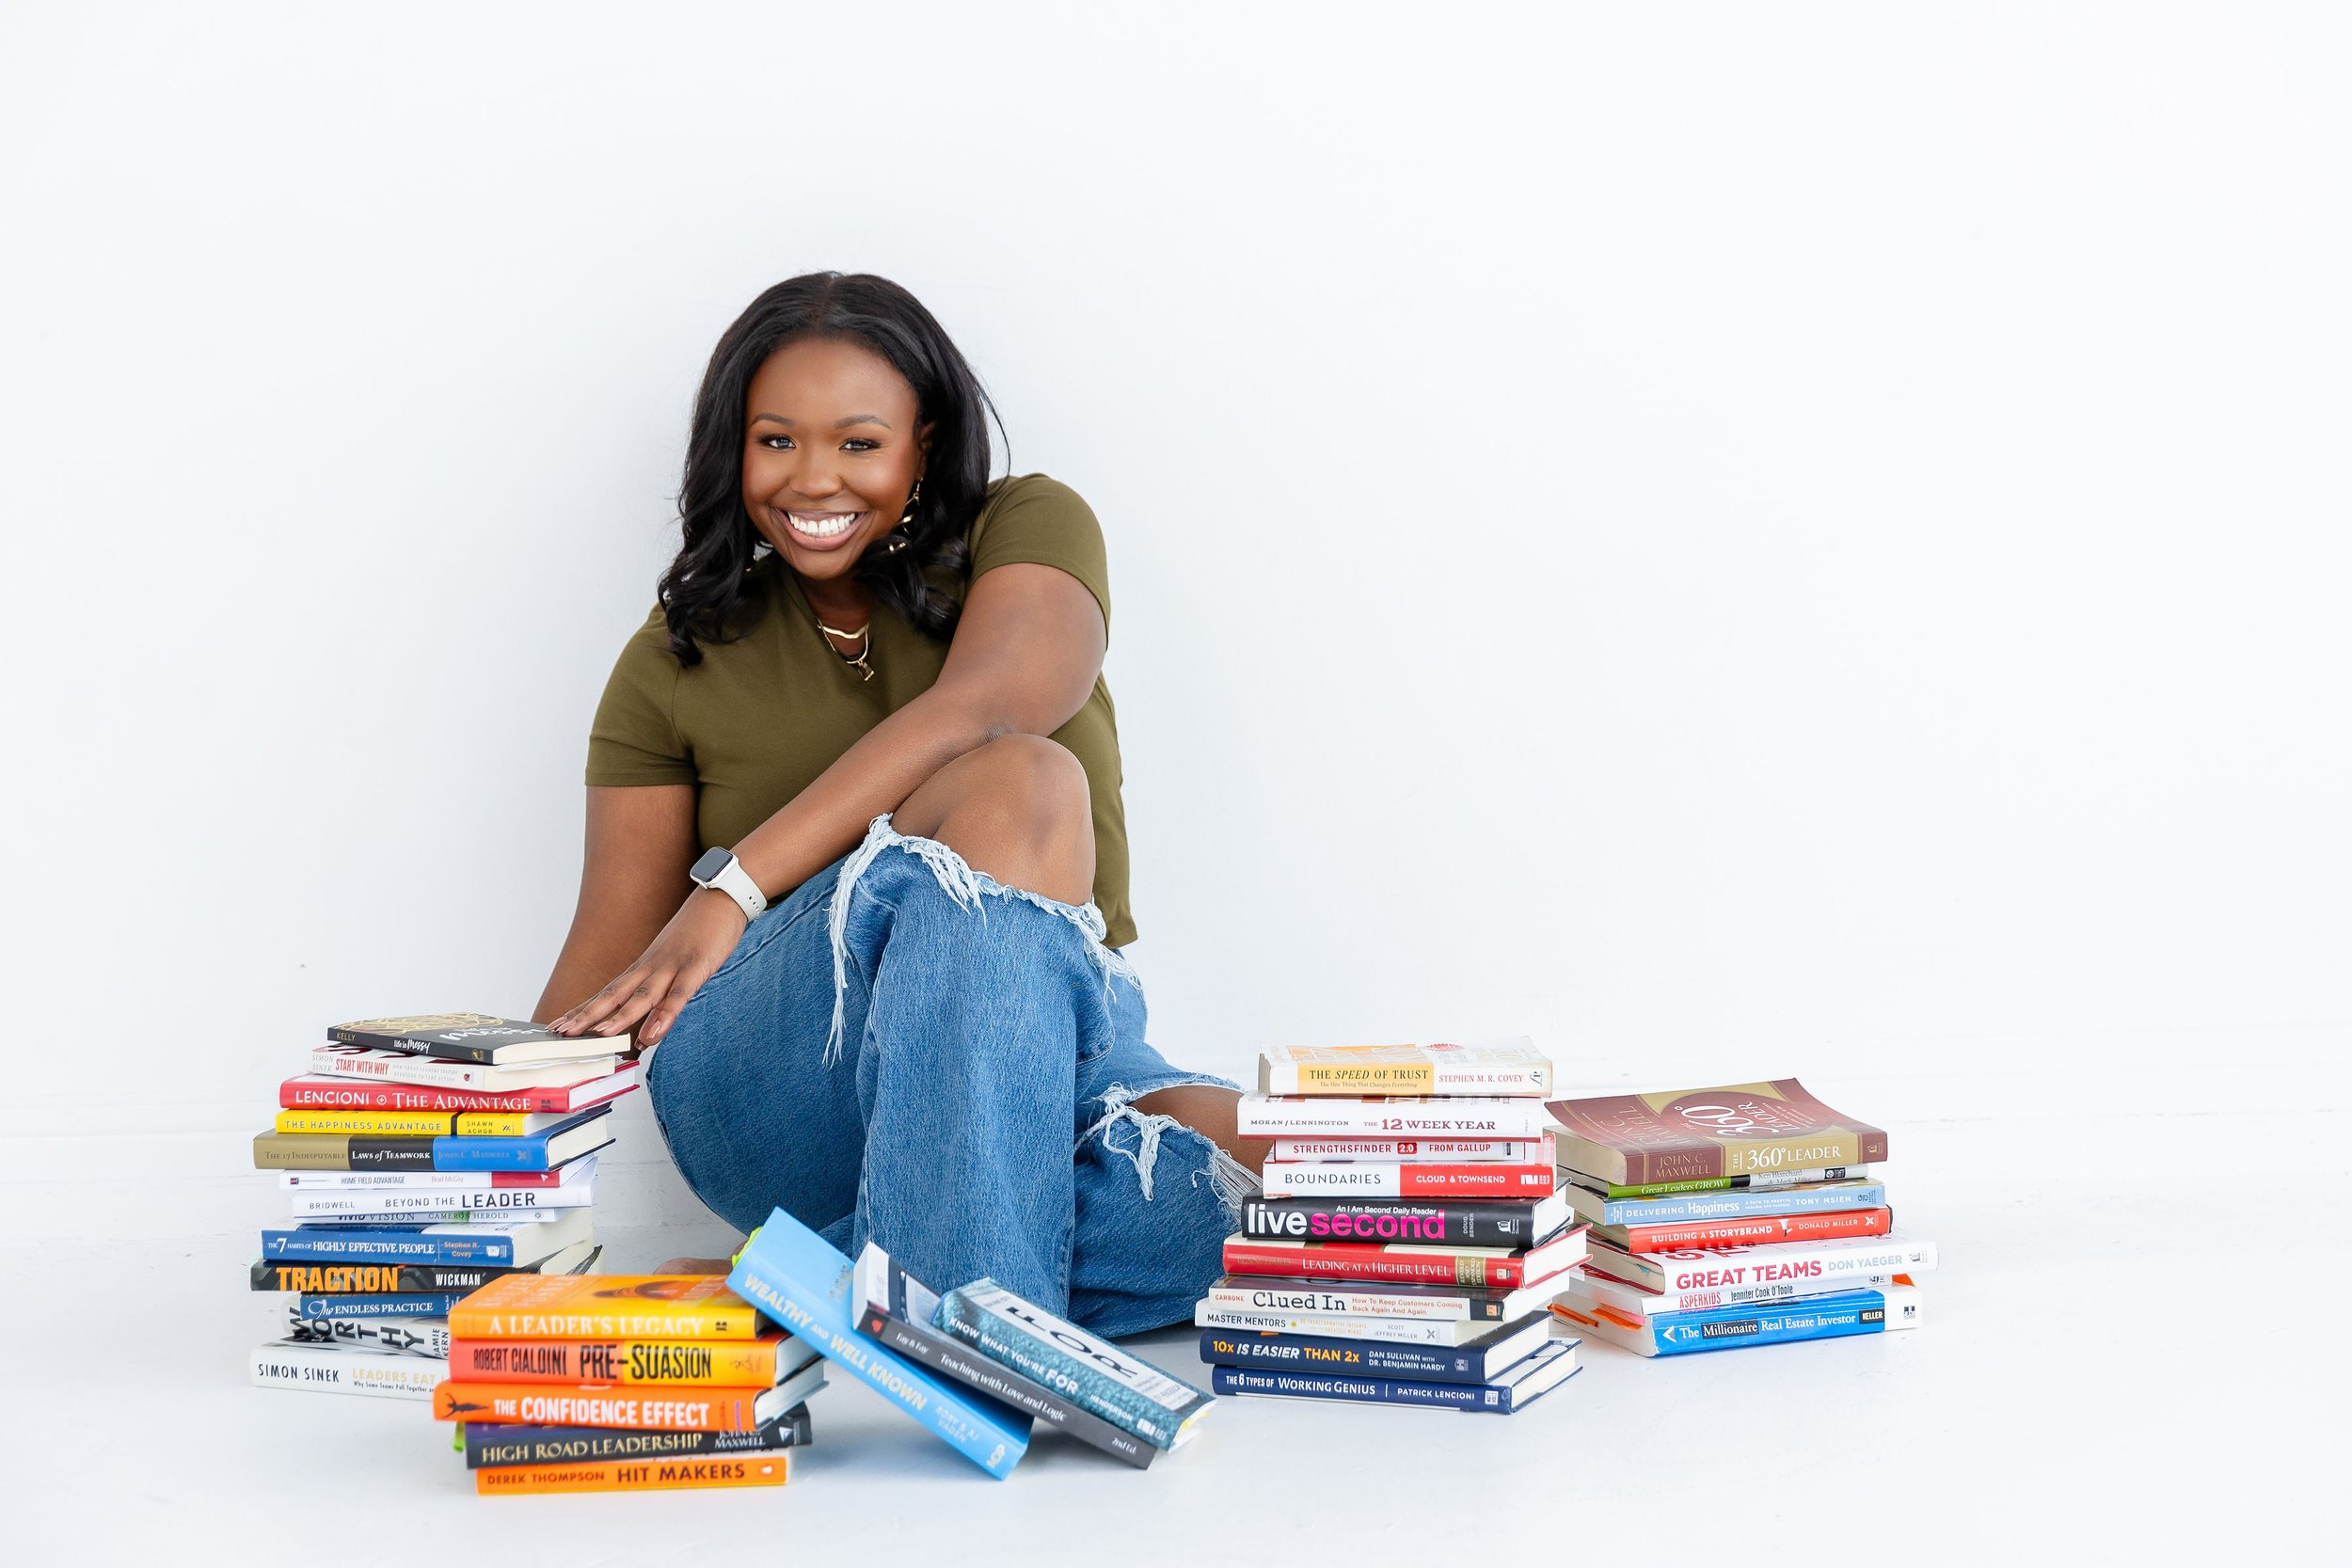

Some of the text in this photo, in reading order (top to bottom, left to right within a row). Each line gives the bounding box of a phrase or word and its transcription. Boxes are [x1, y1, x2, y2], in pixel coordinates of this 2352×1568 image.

[337, 1032, 356, 1041] KELLY
[336, 1059, 389, 1075] START WITH WHY
[1310, 1070, 1330, 1079] THE
[1335, 1070, 1369, 1079] SPEED
[1375, 1070, 1388, 1079] OF
[1392, 1070, 1428, 1080] TRUST
[296, 1091, 532, 1110] LENCIONI THE ADVANTAGE
[1382, 1119, 1403, 1129] 12
[1406, 1120, 1451, 1129] WEEK
[374, 1151, 384, 1162] of
[1294, 1145, 1391, 1153] STRENGTHSFINDER
[1400, 1143, 1414, 1152] 2.0
[1457, 1144, 1490, 1152] GALLUP
[1788, 1147, 1841, 1161] LEADER
[1660, 1154, 1706, 1167] JOHN C.
[1285, 1174, 1381, 1183] BOUNDARIES
[1657, 1165, 1711, 1178] MAXWELL
[1642, 1180, 1725, 1194] Great Leaders GROW
[386, 1198, 429, 1208] BEYOND
[436, 1197, 454, 1206] THE
[462, 1193, 535, 1208] LEADER
[1627, 1207, 1684, 1216] DELIVERING
[1688, 1201, 1740, 1215] Happiness
[1248, 1204, 1445, 1239] live second
[1652, 1233, 1696, 1243] BUILDING
[1708, 1226, 1772, 1238] STORYBRAND
[1799, 1221, 1829, 1229] DONALD
[277, 1238, 286, 1253] 7
[313, 1243, 346, 1252] HIGHLY
[349, 1243, 396, 1251] EFFECTIVE
[398, 1243, 435, 1254] PEOPLE
[1302, 1259, 1349, 1271] LEADING
[1372, 1262, 1412, 1275] HIGHER
[1415, 1264, 1451, 1276] LEVEL
[1677, 1255, 1902, 1290] GREAT TEAMS DON YAEGER
[277, 1267, 480, 1291] TRACTION WICKMAN
[1253, 1291, 1316, 1309] Clued
[1322, 1295, 1345, 1310] In
[1398, 1299, 1435, 1307] Customers
[1437, 1301, 1462, 1309] Coming
[1679, 1292, 1721, 1308] ASPERKIDS
[309, 1300, 433, 1318] The ENDLESS PRACTICE
[489, 1316, 704, 1336] A LEADER'S LEGACY
[1207, 1314, 1286, 1327] MASTER MENTORS
[1679, 1327, 1699, 1338] The
[1703, 1323, 1757, 1336] Millionaire
[1761, 1320, 1782, 1331] Real
[1786, 1318, 1814, 1328] Estate
[1818, 1315, 1855, 1326] Investor
[744, 1274, 814, 1328] WEALTHY
[830, 1334, 866, 1370] WELL
[868, 1361, 928, 1410] KNOWN
[1213, 1340, 1359, 1363] 10x IS EASIER THAN 2x
[474, 1349, 508, 1371] ROBERT
[512, 1347, 566, 1375] CIALDINI
[259, 1365, 339, 1383] SIMON SINEK
[949, 1319, 1133, 1421] KNOW WHAT YOU'RE FOR HENDERSON
[941, 1354, 1068, 1422] Teaching with Love and Logic
[1226, 1373, 1474, 1400] THE 6 TYPES OF WORKING GENIUS PATRICK LENCIONI
[494, 1400, 516, 1415] THE
[521, 1397, 638, 1424] CONFIDENCE
[643, 1402, 709, 1426] EFFECT
[483, 1433, 702, 1463] HIGH ROAD LEADERSHIP
[715, 1436, 766, 1449] MAXWELL
[488, 1465, 744, 1484] DEREK THOMPSON HIT MAKERS
